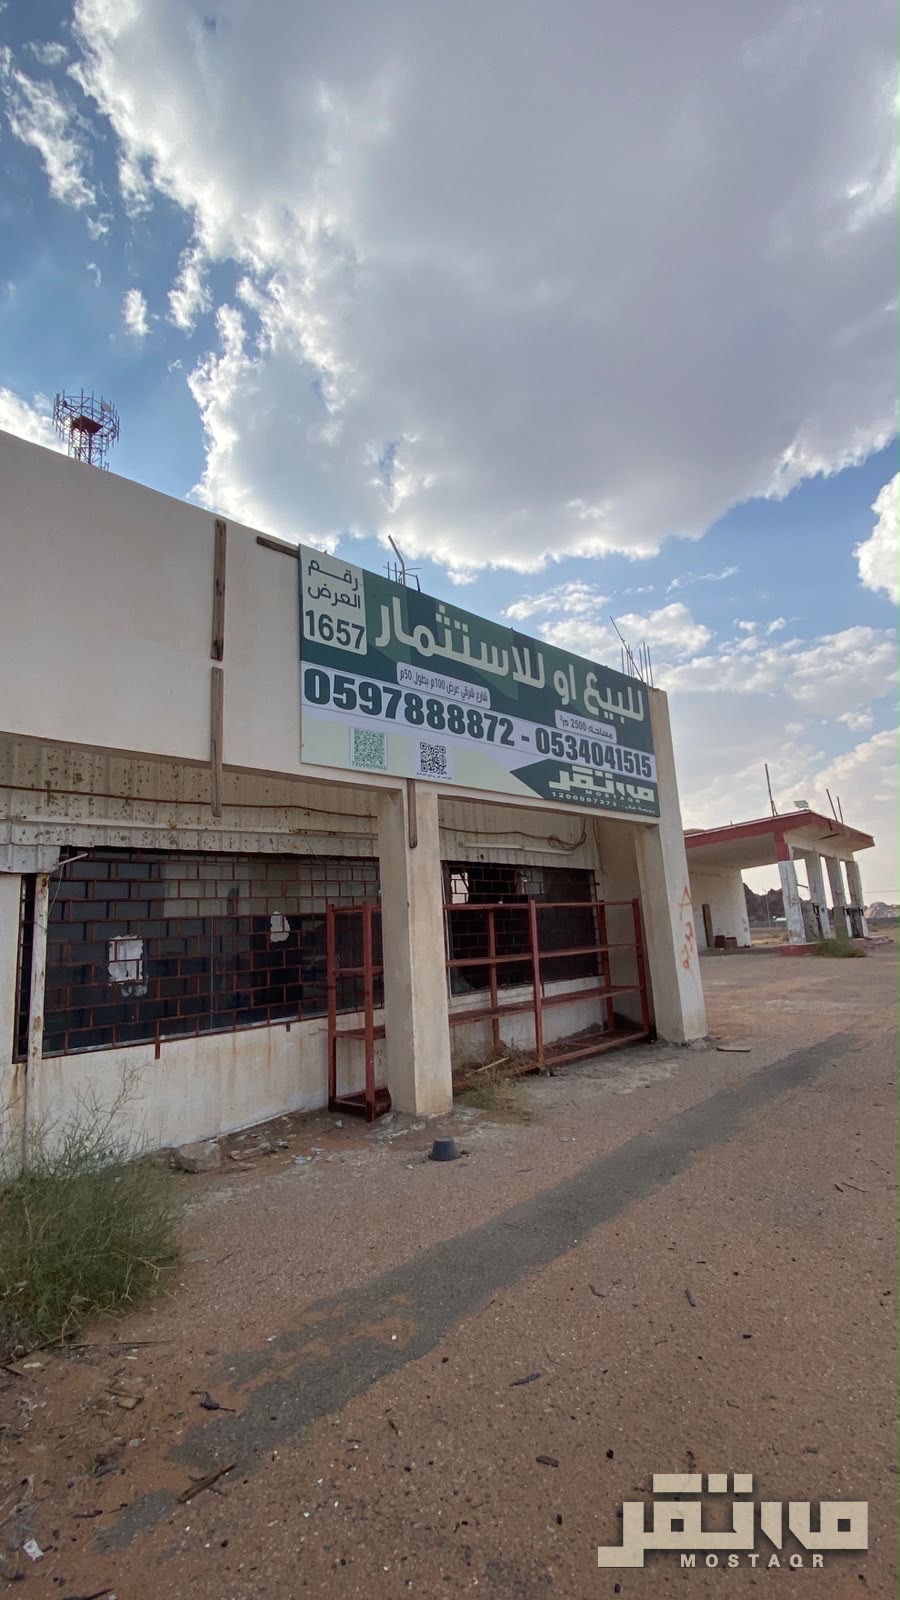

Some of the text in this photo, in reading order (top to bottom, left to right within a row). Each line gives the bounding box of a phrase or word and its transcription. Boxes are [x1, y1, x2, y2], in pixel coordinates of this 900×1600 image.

[308, 560, 358, 591] رقم
[308, 584, 360, 609] العرض
[305, 610, 365, 649] 1657
[375, 597, 644, 723] للبيع او للاستثمار
[414, 672, 429, 687] بطول
[446, 682, 459, 695] عرض
[461, 686, 475, 700] شرقي
[476, 691, 488, 703] شارع
[304, 668, 515, 746] 0597888872
[536, 731, 652, 778] 0534041515
[570, 719, 587, 731] 2500
[552, 791, 617, 806] 1200007373
[585, 789, 640, 803] MOSTAQR
